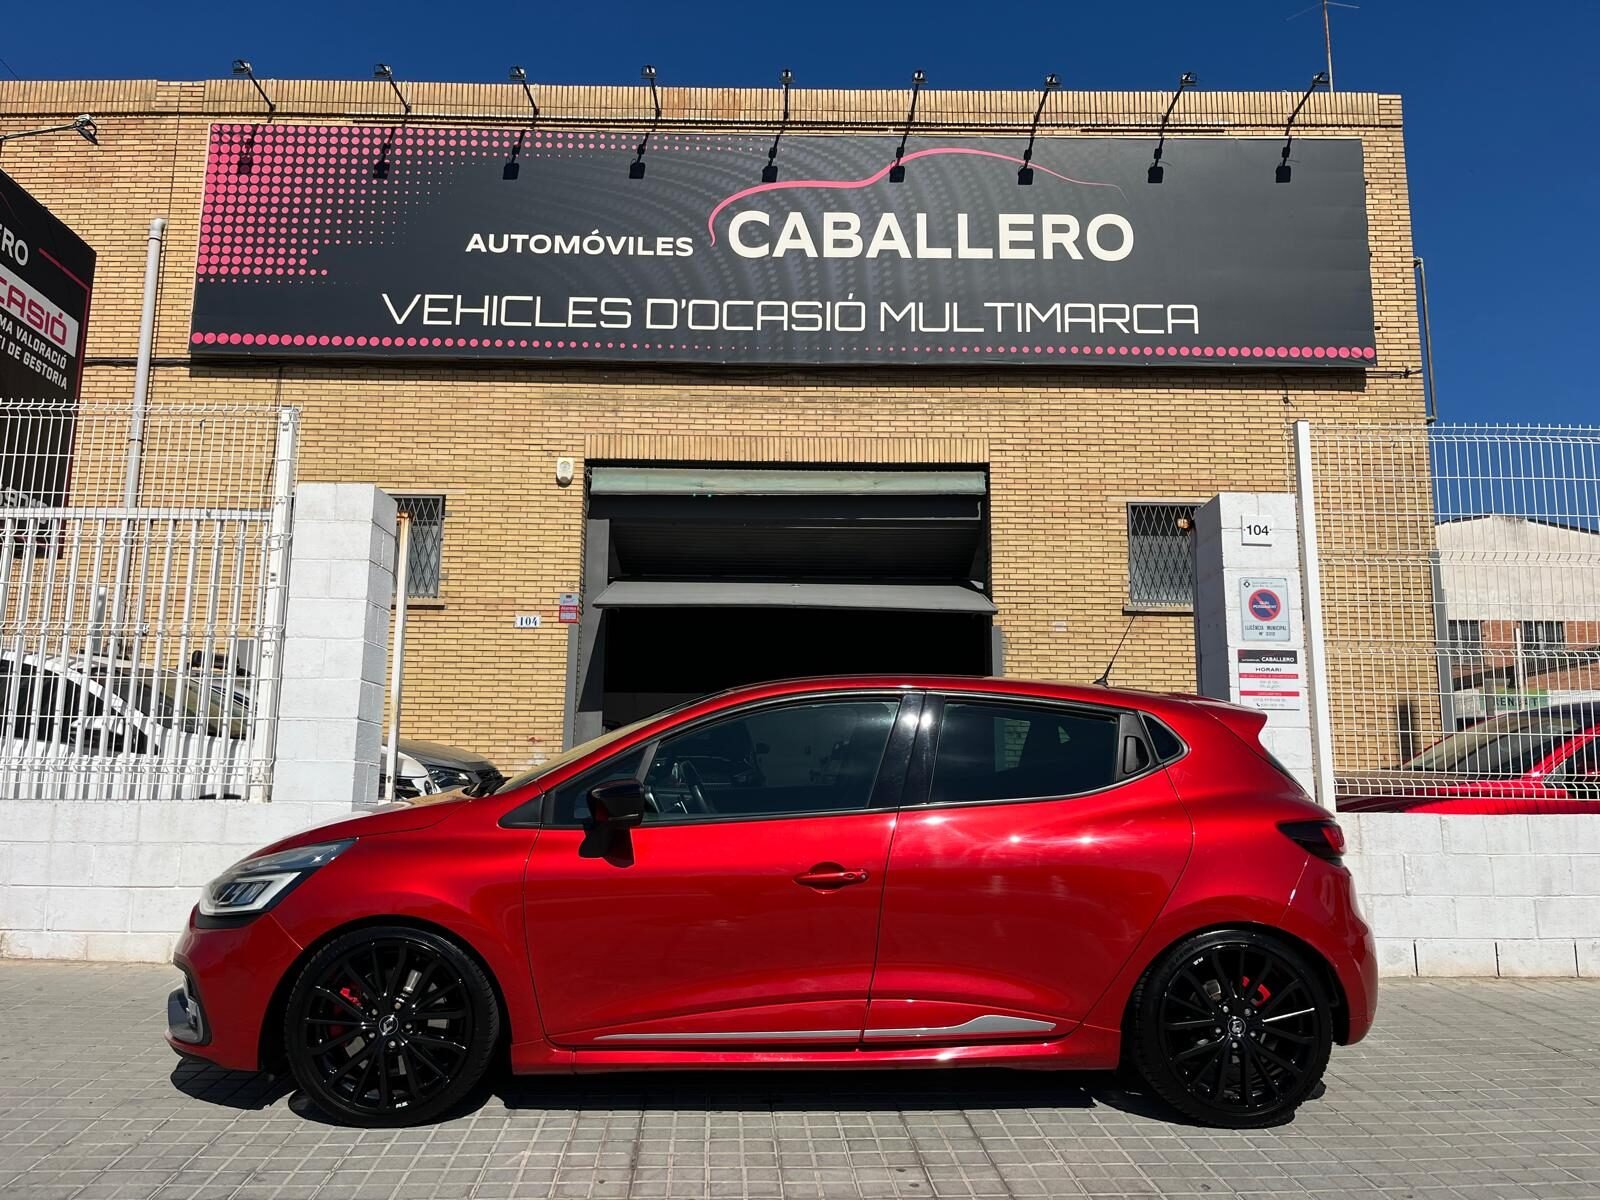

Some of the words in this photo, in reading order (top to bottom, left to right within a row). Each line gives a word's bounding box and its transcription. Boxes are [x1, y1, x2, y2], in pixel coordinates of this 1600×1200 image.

[465, 229, 694, 257] AUTOMÓVILES
[728, 210, 1135, 262] CABALLERO
[381, 293, 632, 328] VEHICLES
[645, 292, 866, 332] D'OCASIÓ
[880, 301, 1200, 334] MULTIMARCA
[7, 341, 20, 360] DE
[23, 352, 68, 390] GESTORIA
[16, 325, 67, 370] VALORACIÓ
[520, 616, 537, 626] 104
